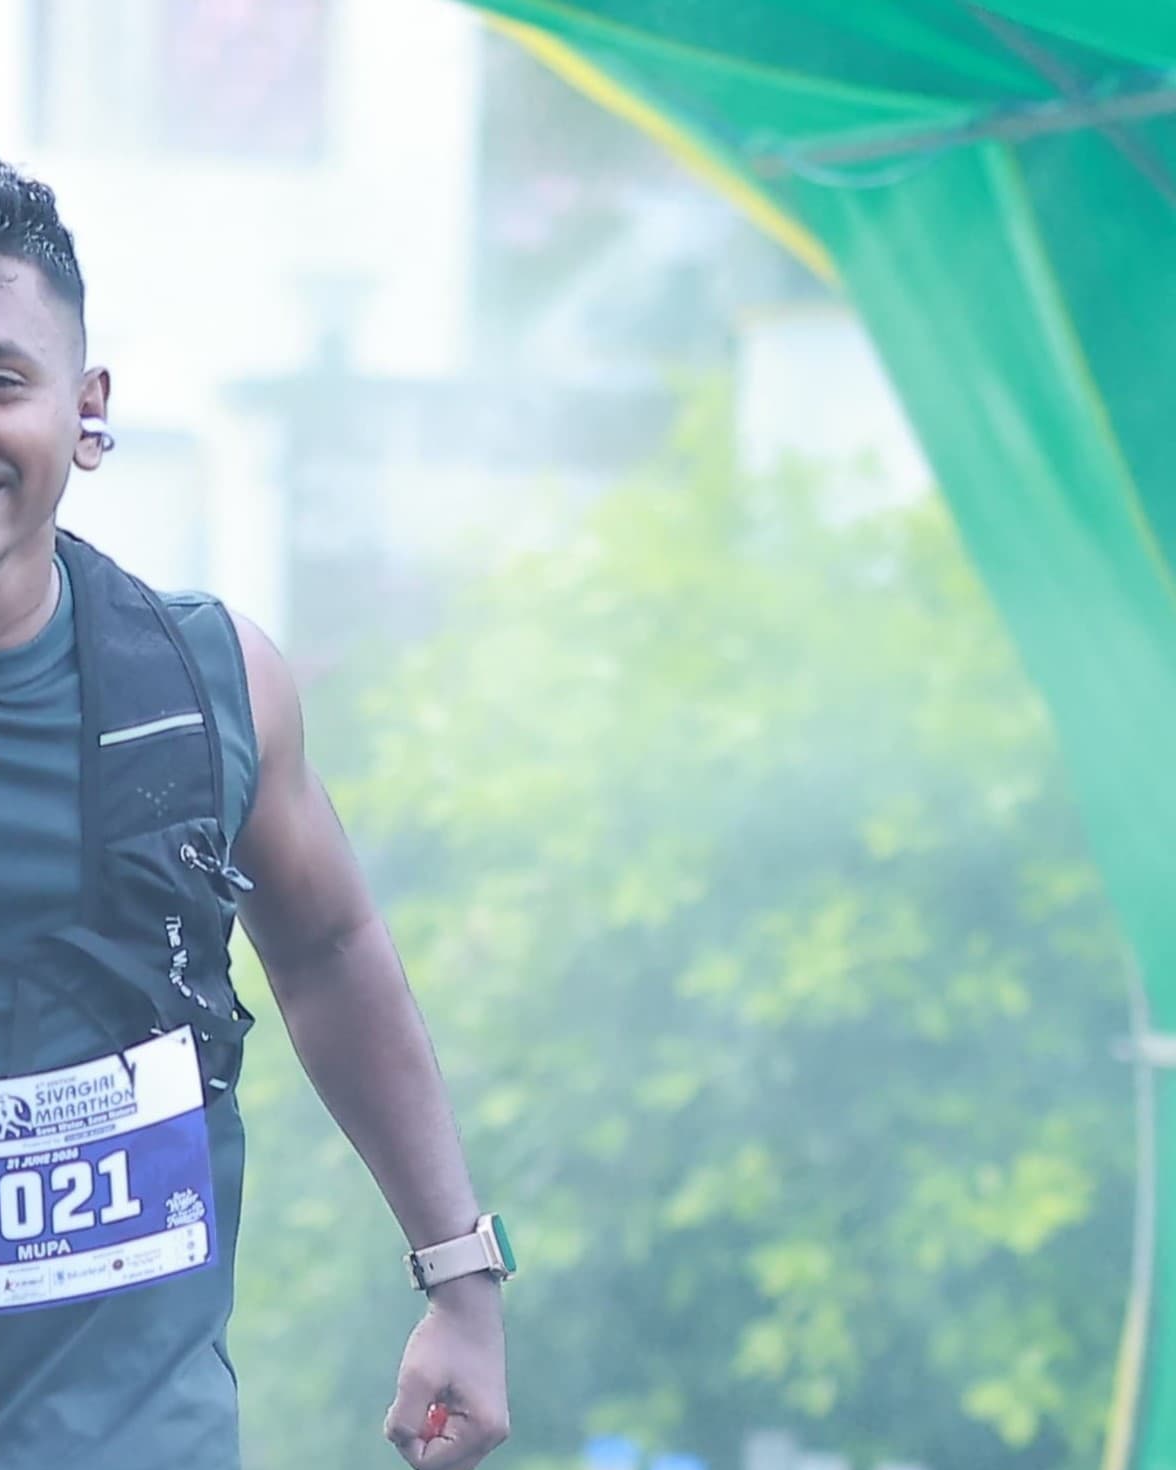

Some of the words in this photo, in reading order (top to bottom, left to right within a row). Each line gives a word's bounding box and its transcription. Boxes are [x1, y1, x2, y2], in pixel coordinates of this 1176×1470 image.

[35, 1074, 115, 1107] SIVAGIRI
[34, 1088, 135, 1125] MARATHON
[21, 1152, 51, 1168] JUNE
[17, 1238, 72, 1261] MUPA
